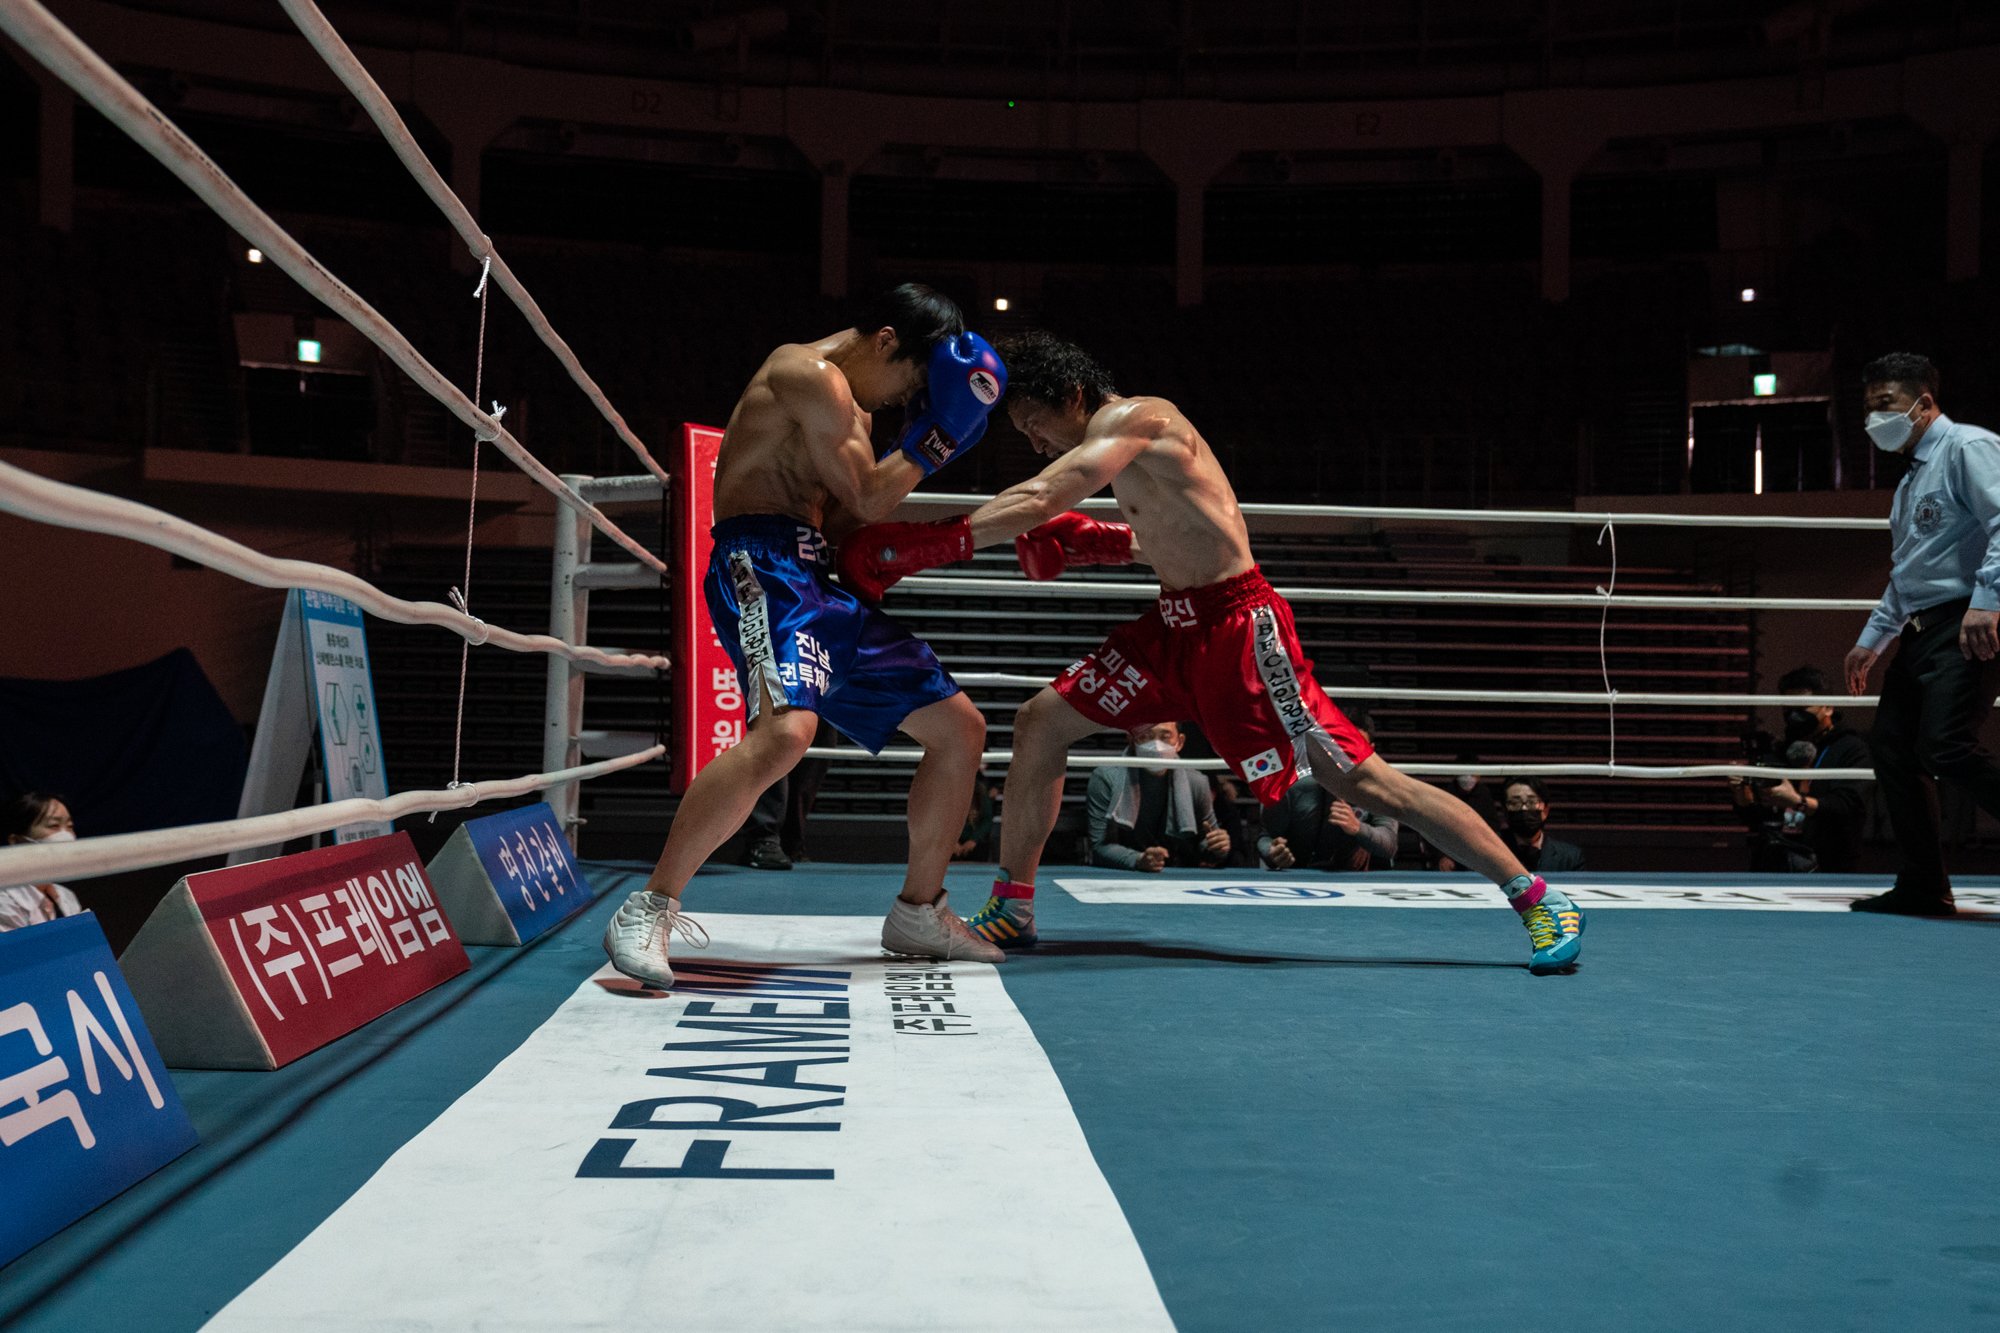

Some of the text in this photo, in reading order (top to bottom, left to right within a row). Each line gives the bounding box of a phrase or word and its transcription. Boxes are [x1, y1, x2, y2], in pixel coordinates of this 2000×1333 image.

[631, 90, 661, 115] D2
[1088, 648, 1149, 697] 피릿
[229, 862, 451, 1021] (주)프레임엠
